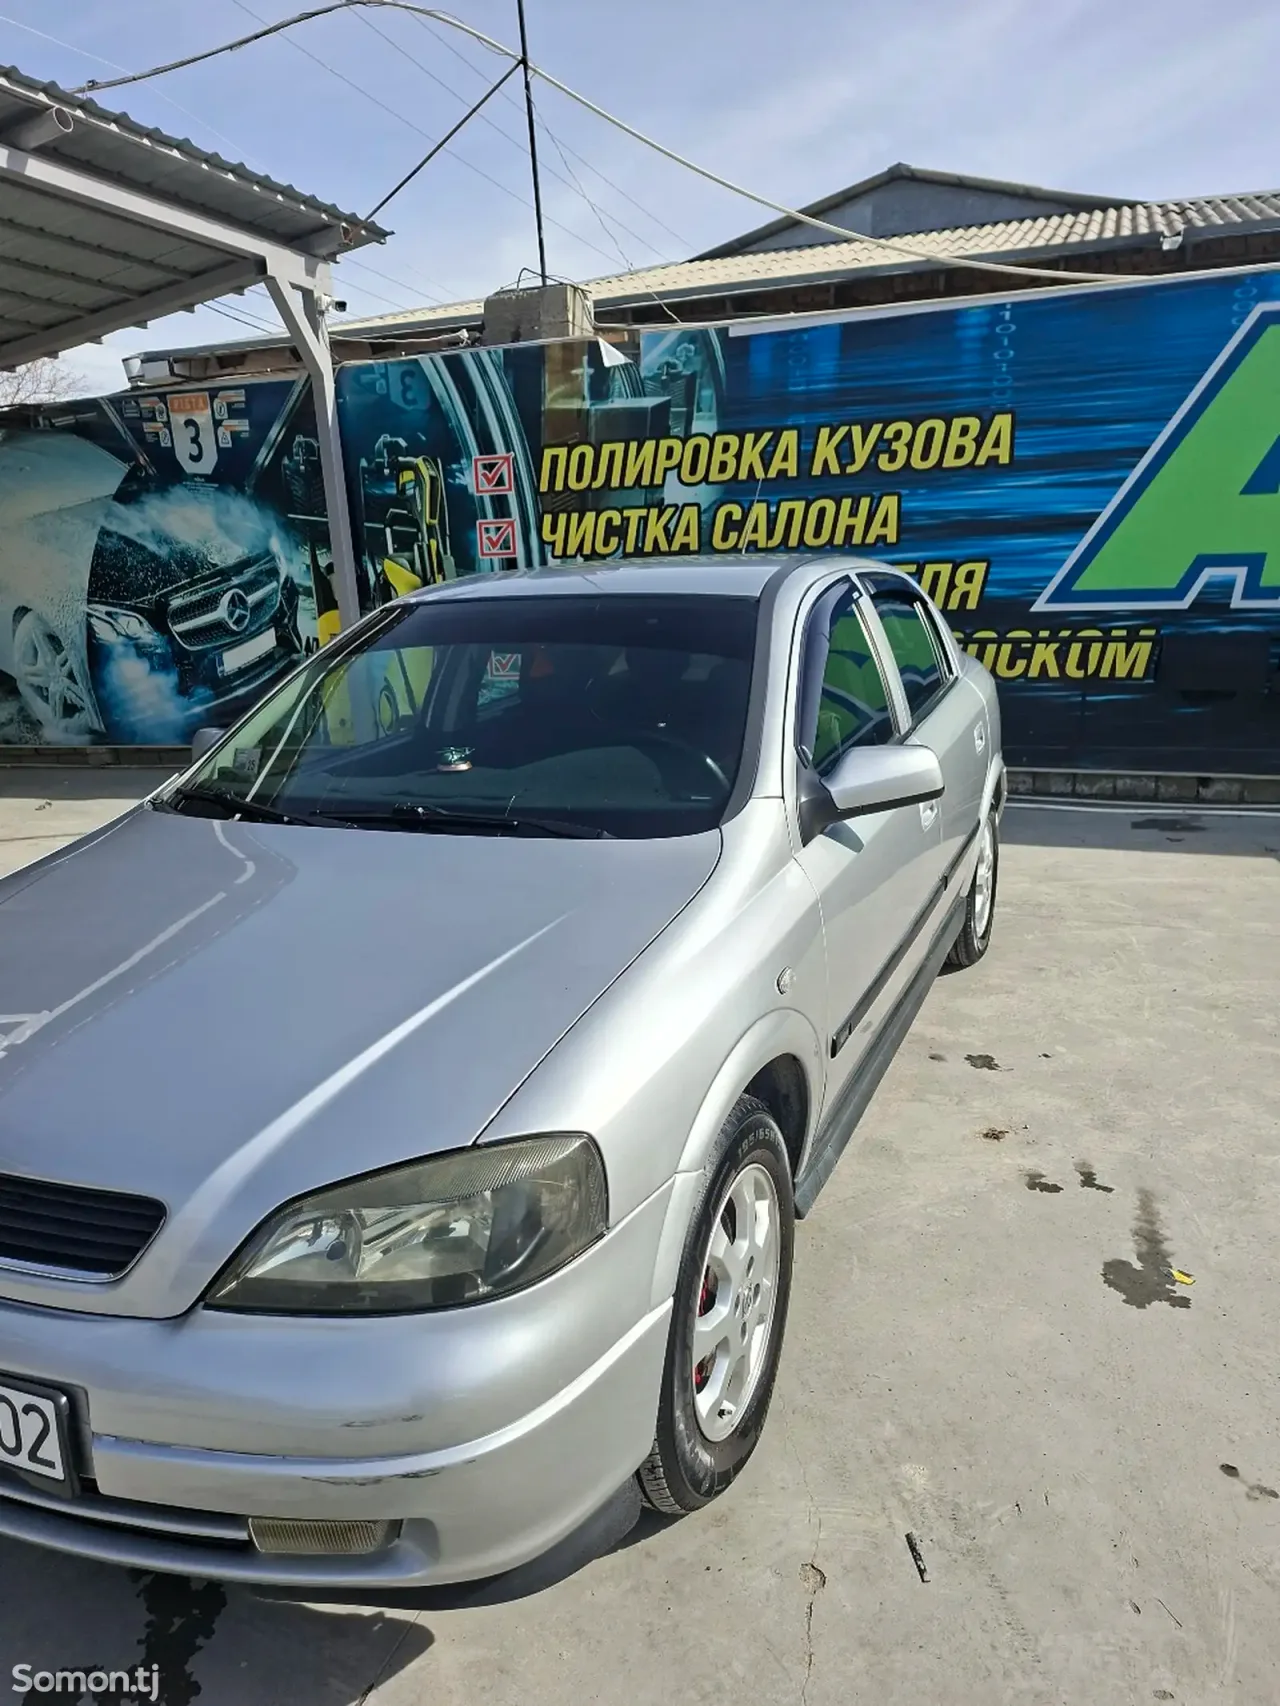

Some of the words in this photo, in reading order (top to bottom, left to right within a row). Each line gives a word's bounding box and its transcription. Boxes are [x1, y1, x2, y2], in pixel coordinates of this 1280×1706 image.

[183, 418, 204, 463] 3
[540, 430, 798, 493] ПОЛИРОВКА
[811, 413, 1012, 476] КУЗОВА
[541, 505, 699, 557] ЧИСТКА
[712, 495, 899, 551] САЛОНА
[951, 629, 1157, 678] ОСКОМ
[0, 1393, 56, 1470] 02
